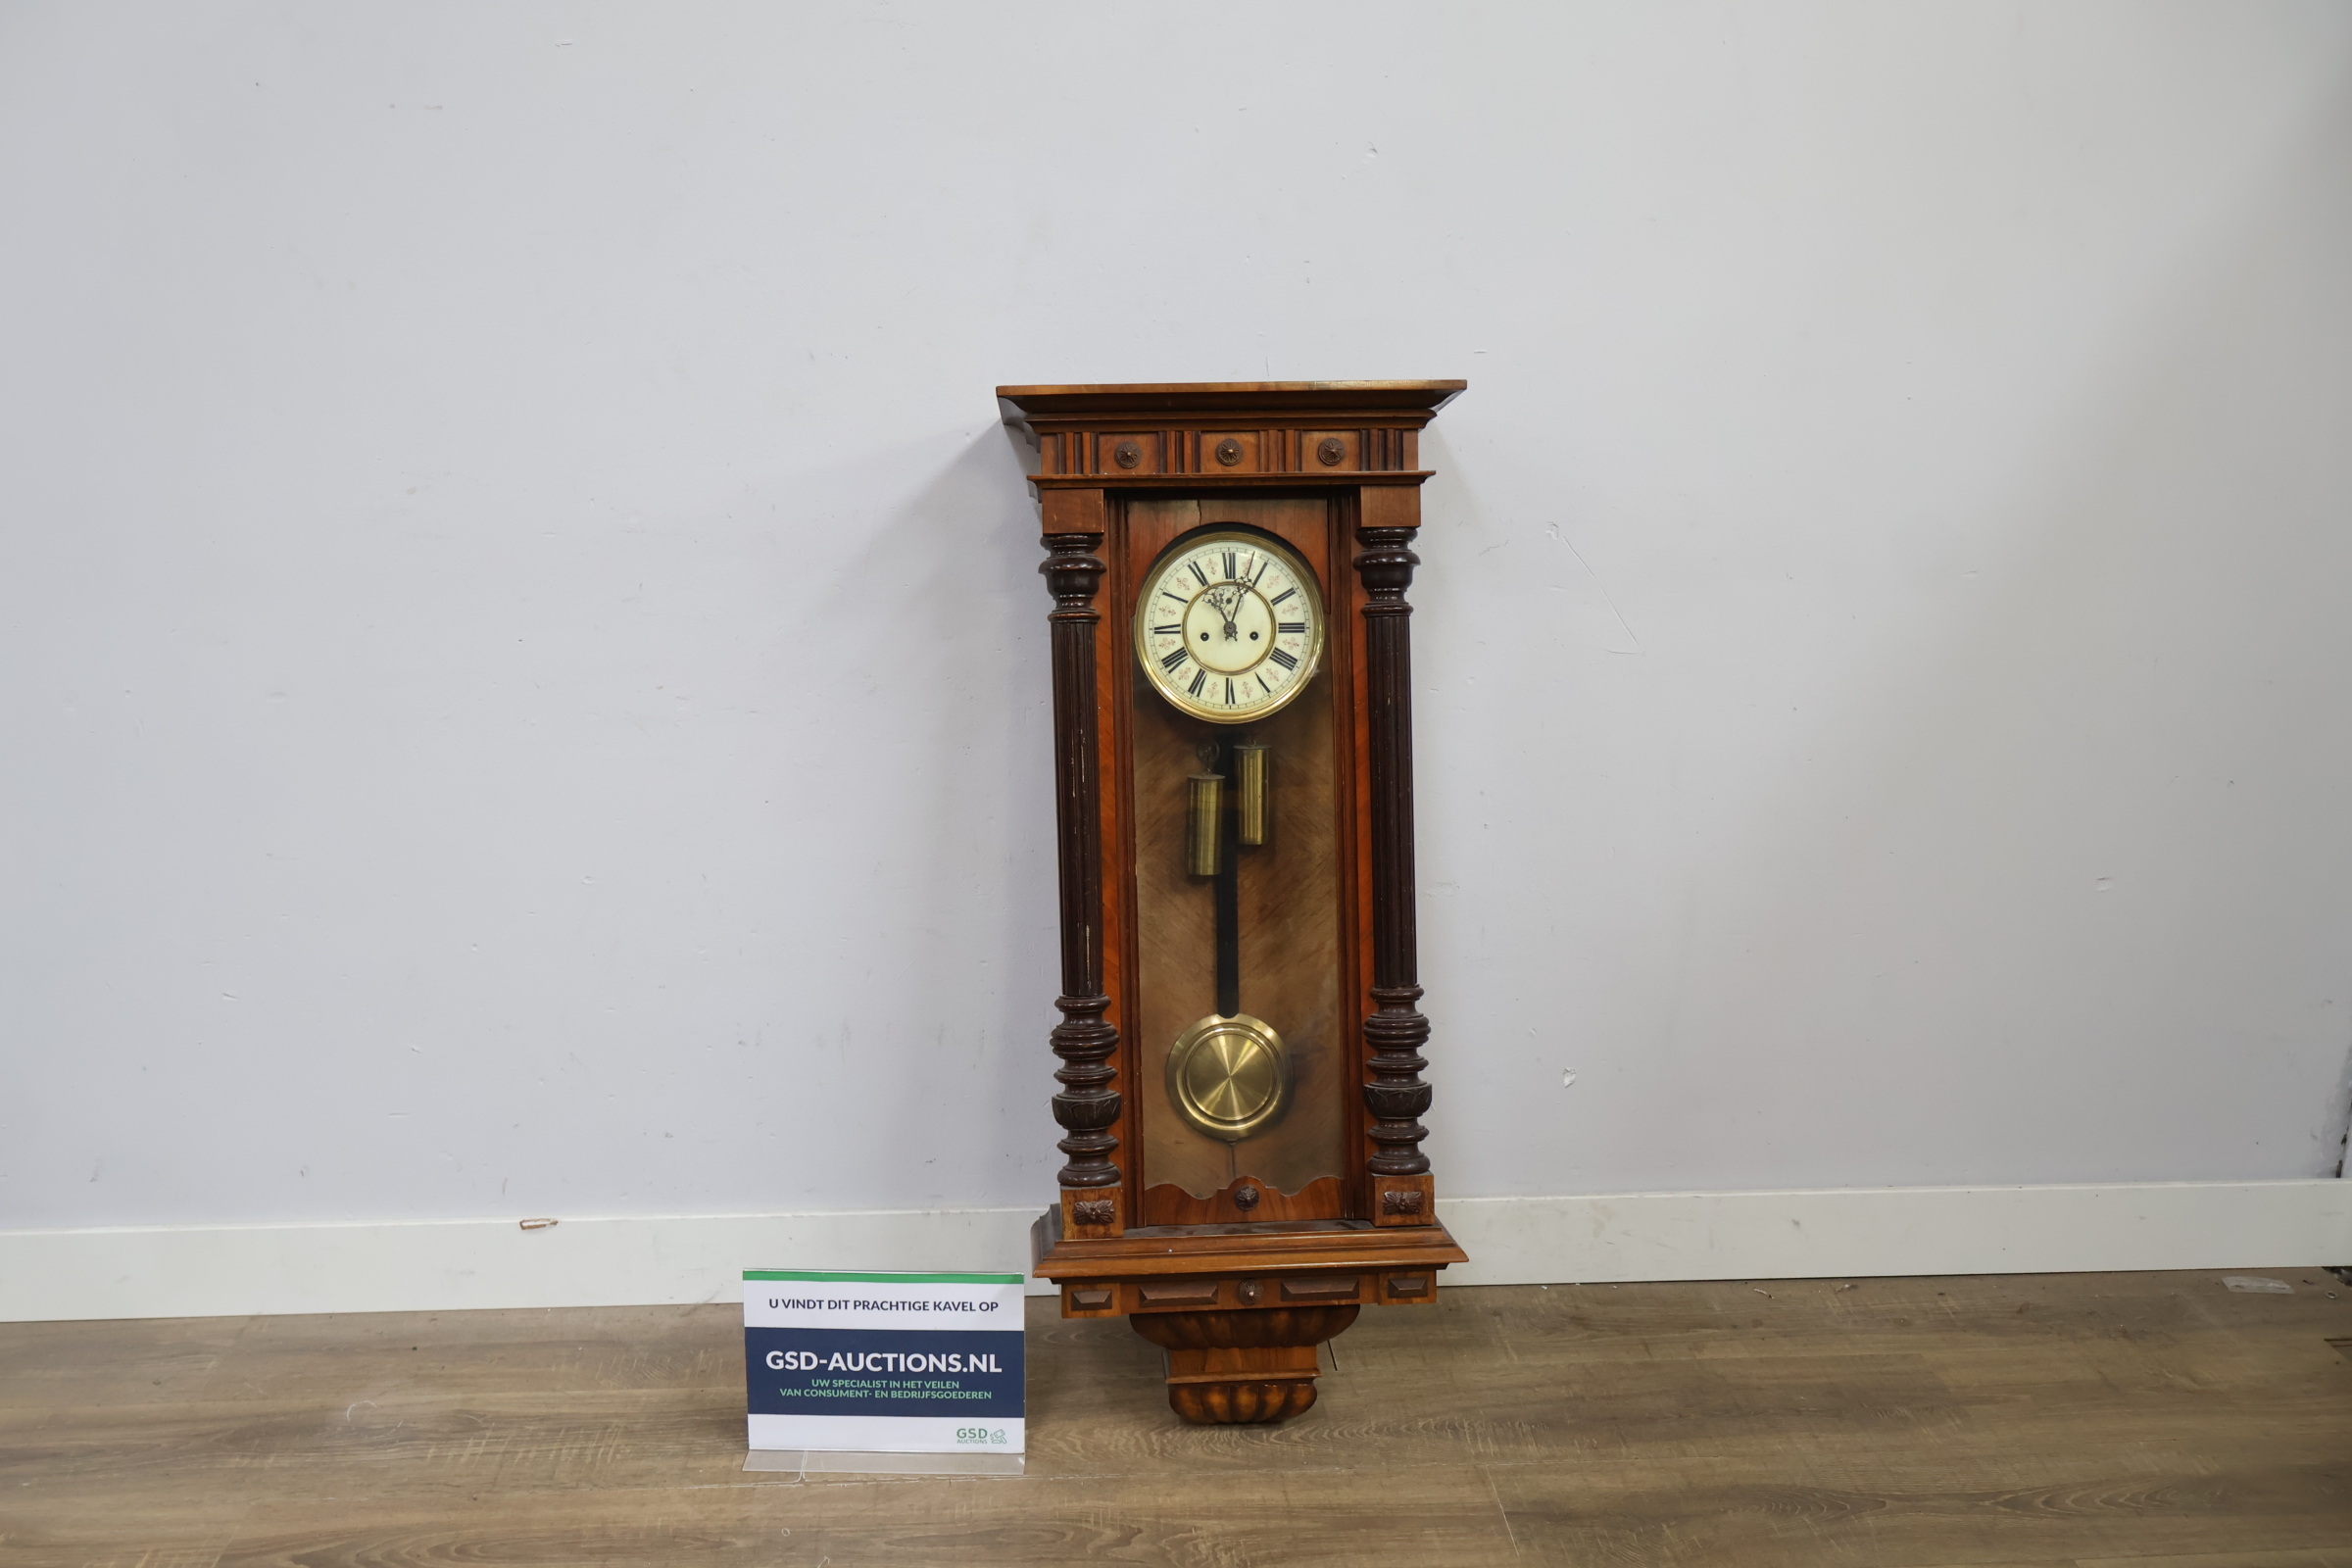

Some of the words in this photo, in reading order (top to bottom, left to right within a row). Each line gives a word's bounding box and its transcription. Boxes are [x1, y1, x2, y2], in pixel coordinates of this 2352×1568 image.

[768, 1298, 779, 1309] U
[781, 1298, 825, 1310] VINDT
[827, 1299, 851, 1310] DIT
[853, 1300, 930, 1311] PRACHTIGE
[933, 1301, 976, 1312] KAVEL
[978, 1301, 1000, 1312] OP
[765, 1350, 1003, 1373] GSD-AUCTIONS.NL
[811, 1379, 831, 1388] UW
[832, 1379, 888, 1389] SPECIALIST
[889, 1380, 901, 1389] IN
[903, 1380, 923, 1390] HET
[924, 1380, 959, 1390] VEILEN
[779, 1388, 802, 1397] VAN
[803, 1389, 873, 1398] CONSUMENT-
[874, 1390, 889, 1398] EN
[890, 1390, 992, 1399] BEDRIJFSGOEDEREN
[956, 1428, 988, 1439] GSD
